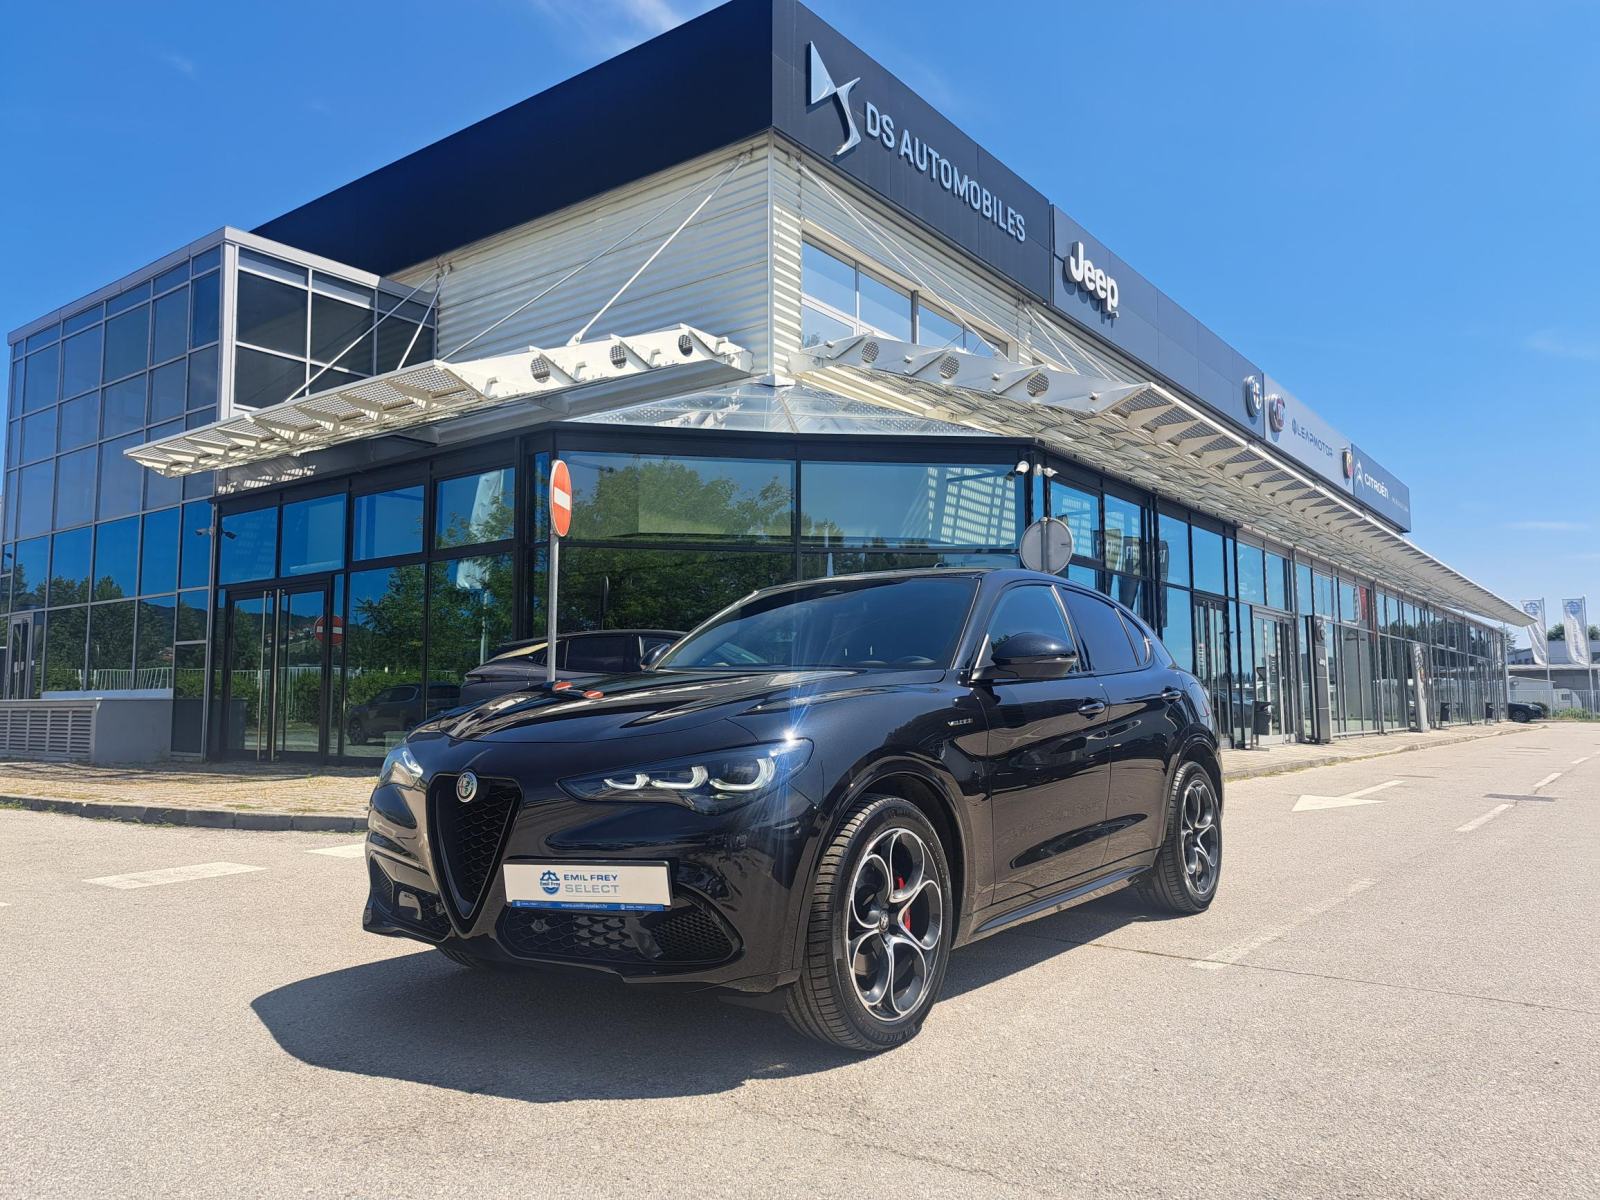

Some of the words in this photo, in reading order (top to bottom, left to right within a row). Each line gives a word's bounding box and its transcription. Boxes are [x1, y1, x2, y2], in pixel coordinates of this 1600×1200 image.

[865, 101, 895, 148] DS
[899, 129, 1026, 242] AUTOMOBILES
[1065, 241, 1119, 313] Jeep
[563, 874, 588, 882] EMIL
[590, 874, 618, 882] FREY
[564, 884, 620, 894] SELECT
